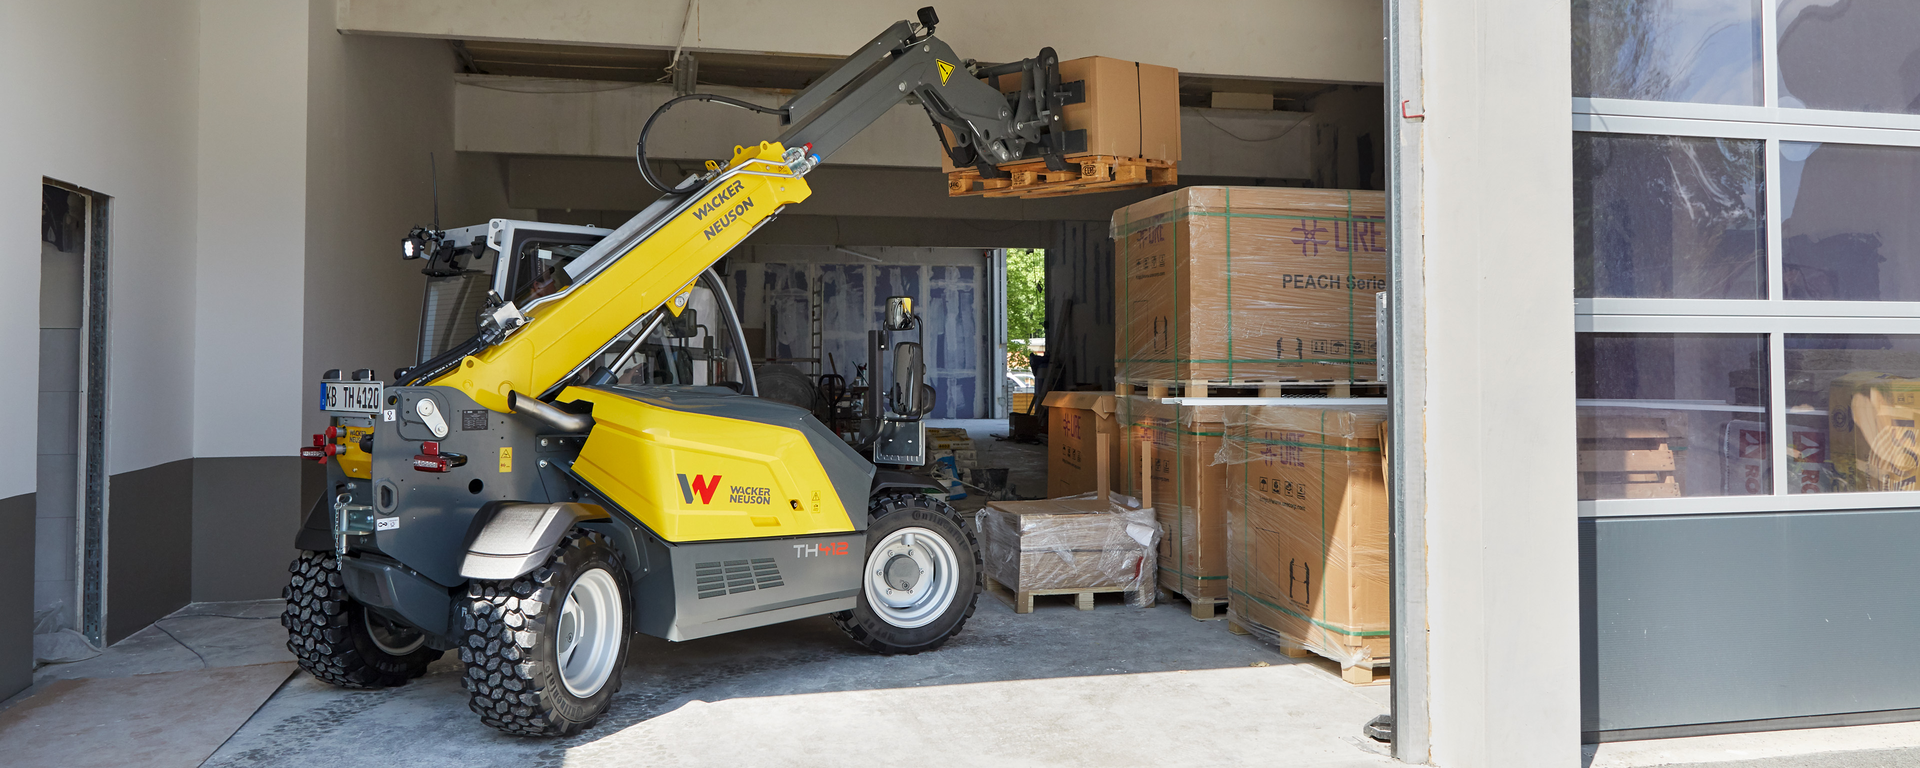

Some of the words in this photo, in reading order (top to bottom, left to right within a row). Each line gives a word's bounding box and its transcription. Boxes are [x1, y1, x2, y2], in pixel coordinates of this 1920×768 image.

[692, 179, 744, 221] WACKER
[703, 197, 755, 240] NEUSON
[1333, 215, 1386, 252] URE
[1282, 274, 1341, 290] PEACH
[1346, 275, 1386, 290] Serie
[326, 386, 337, 408] KB
[343, 386, 355, 409] TH
[356, 387, 380, 409] 4120
[1070, 413, 1082, 440] URE
[1280, 432, 1305, 468] URE
[729, 485, 771, 497] WACKER
[729, 495, 771, 505] NEUSON
[793, 541, 849, 558] TH412
[546, 672, 584, 719] Continental
